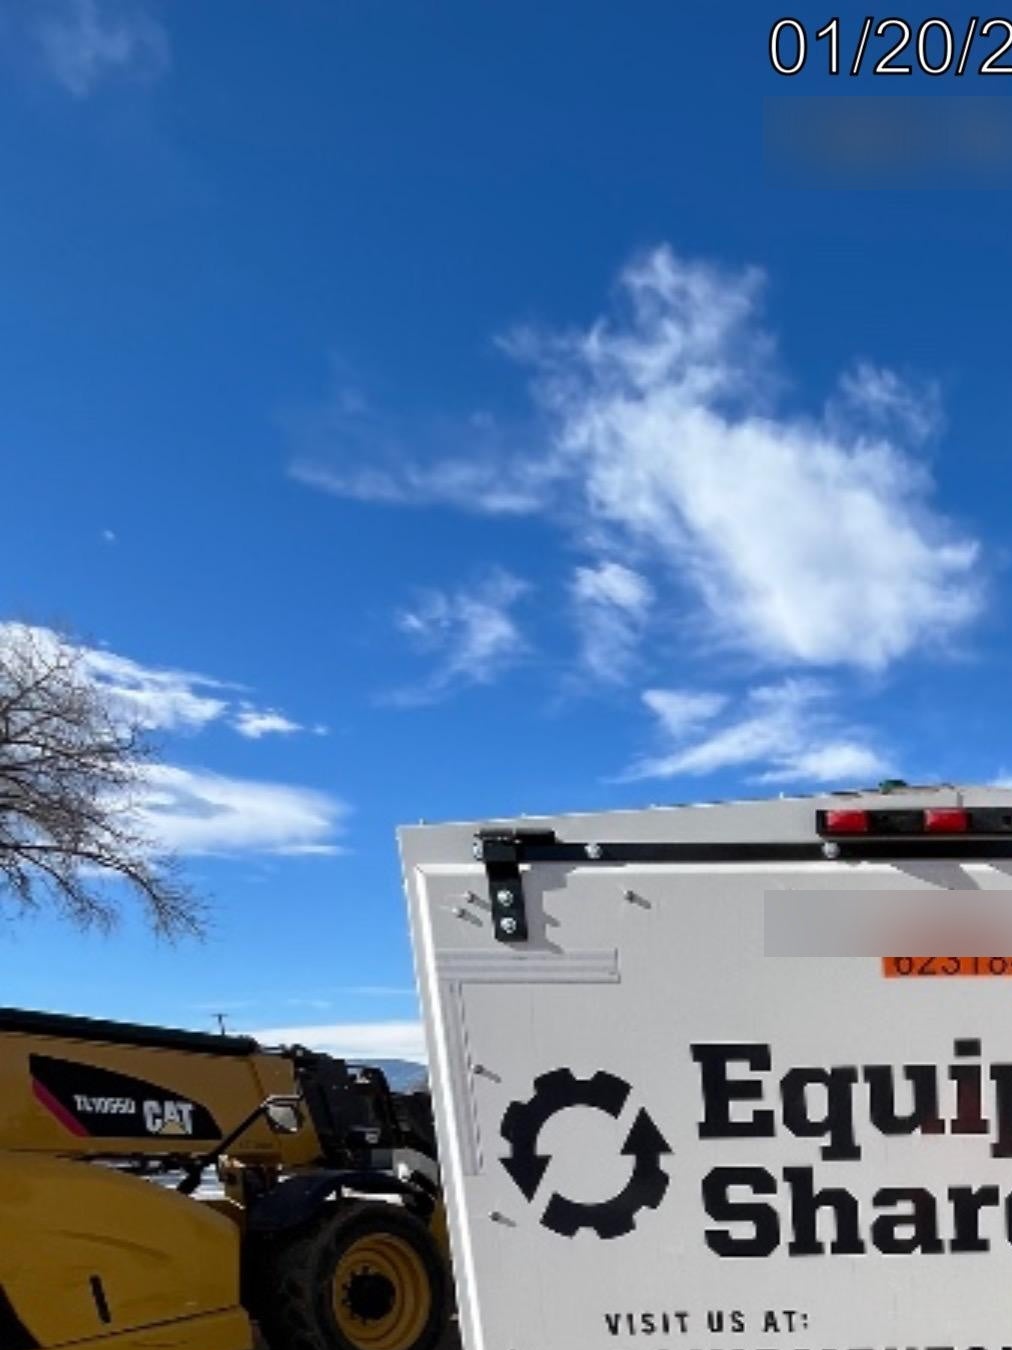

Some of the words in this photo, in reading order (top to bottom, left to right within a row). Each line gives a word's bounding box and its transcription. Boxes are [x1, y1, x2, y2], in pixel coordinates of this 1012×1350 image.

[142, 1100, 194, 1135] CAT
[606, 1313, 688, 1336] VISIT
[708, 1311, 745, 1333] US
[764, 1311, 812, 1332] AT:
